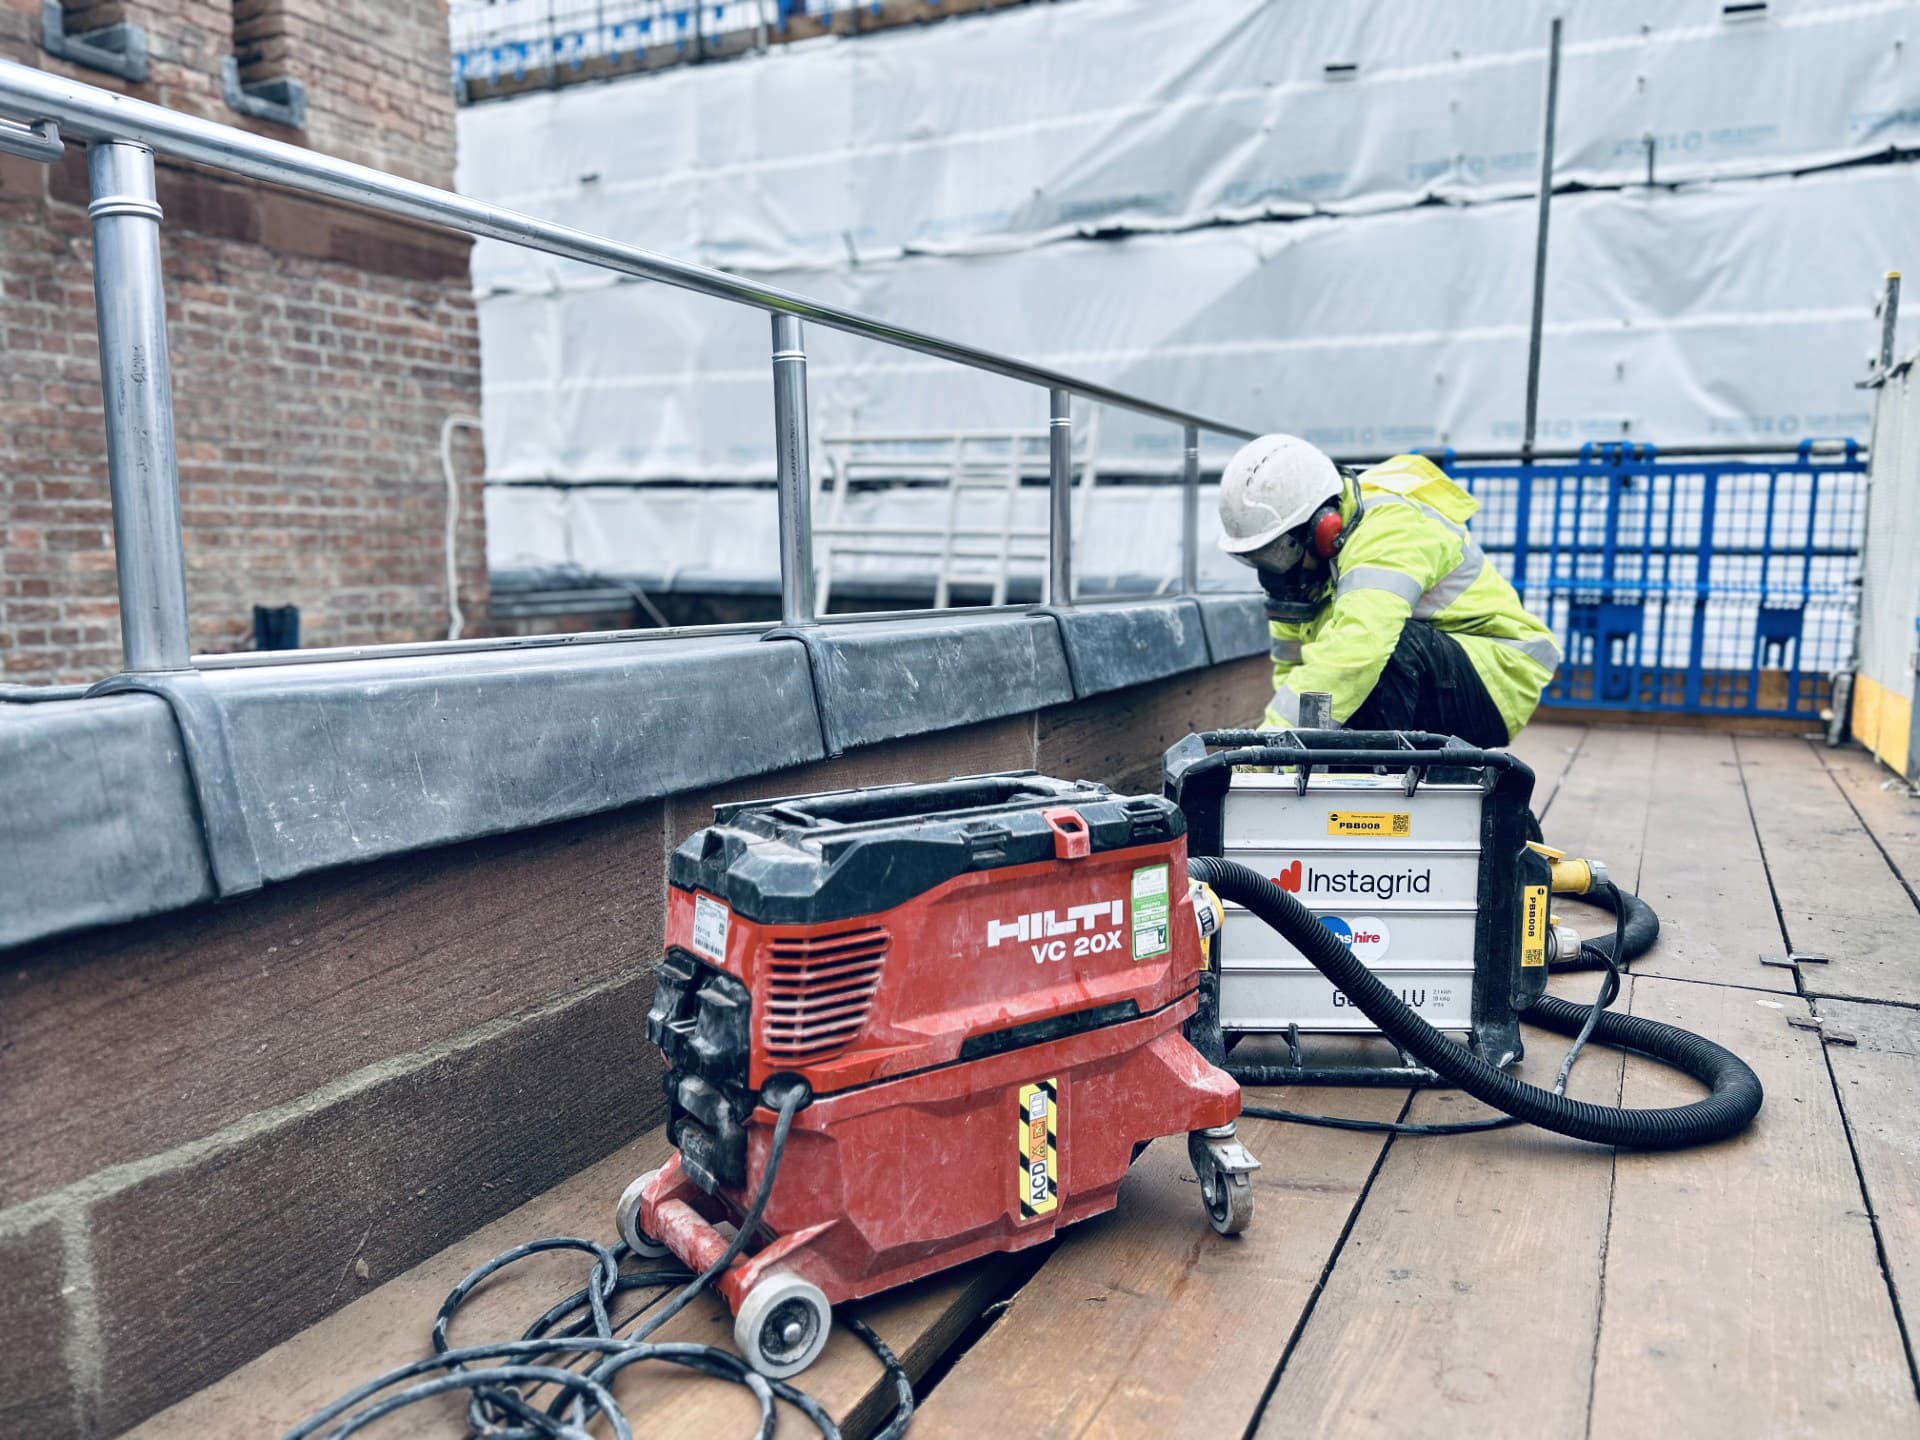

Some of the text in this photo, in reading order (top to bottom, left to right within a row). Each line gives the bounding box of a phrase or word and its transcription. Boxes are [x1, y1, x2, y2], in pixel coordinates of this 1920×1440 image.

[1307, 867, 1430, 900] Instagrid
[987, 899, 1123, 948] HILTI
[1528, 897, 1536, 937] PBB008
[1031, 941, 1067, 964] VC
[1073, 930, 1122, 957] 20X
[1353, 931, 1381, 943] hire
[1402, 989, 1425, 1007] LV
[1032, 1162, 1046, 1201] ACD
